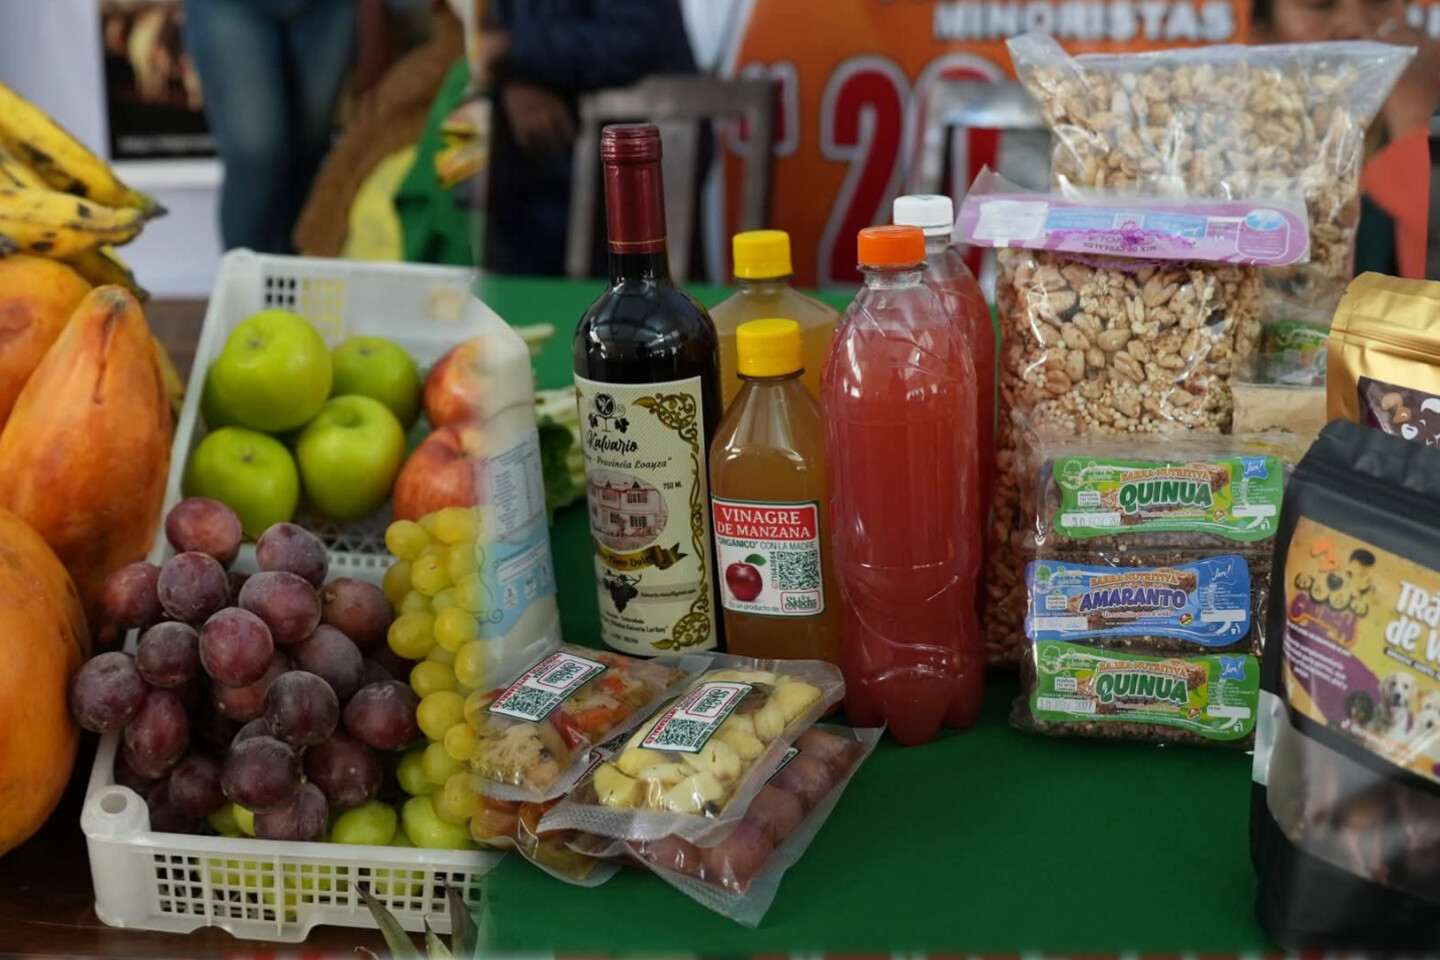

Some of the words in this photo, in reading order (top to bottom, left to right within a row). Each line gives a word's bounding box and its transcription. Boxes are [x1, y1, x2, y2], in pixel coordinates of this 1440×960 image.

[1119, 480, 1214, 515] QUINUA
[721, 507, 801, 524] VINAGRE
[717, 521, 733, 535] DE
[736, 524, 811, 538] MANZANA
[760, 541, 777, 550] CON
[778, 542, 788, 550] LA
[789, 541, 816, 550] MADRE
[1079, 587, 1187, 613] AMARANTO
[1385, 616, 1421, 651] de
[1095, 673, 1190, 705] QUINUA
